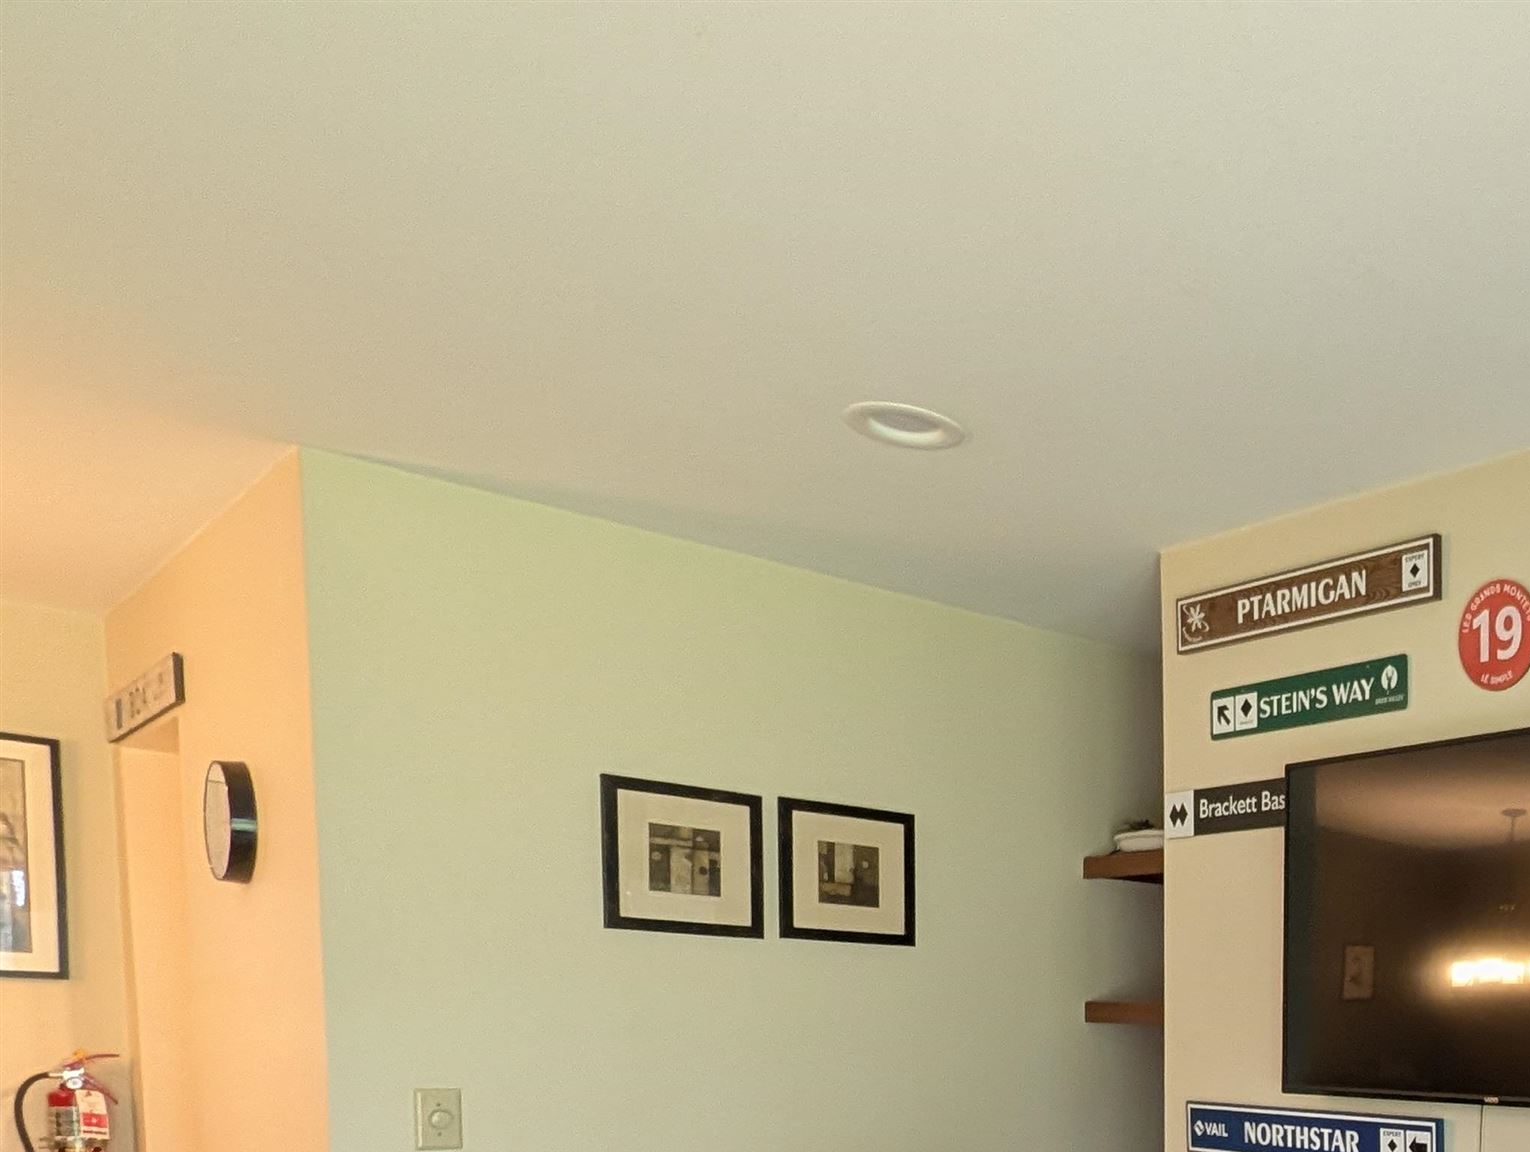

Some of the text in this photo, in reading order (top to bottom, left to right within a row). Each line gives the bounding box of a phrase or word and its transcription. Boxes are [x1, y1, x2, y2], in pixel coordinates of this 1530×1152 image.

[1237, 569, 1366, 624] PTARMIGAN
[1472, 605, 1522, 662] 19
[1259, 677, 1375, 718] STEIN'S WAY
[1199, 796, 1257, 819] Brackett
[1204, 1121, 1229, 1137] VAIL
